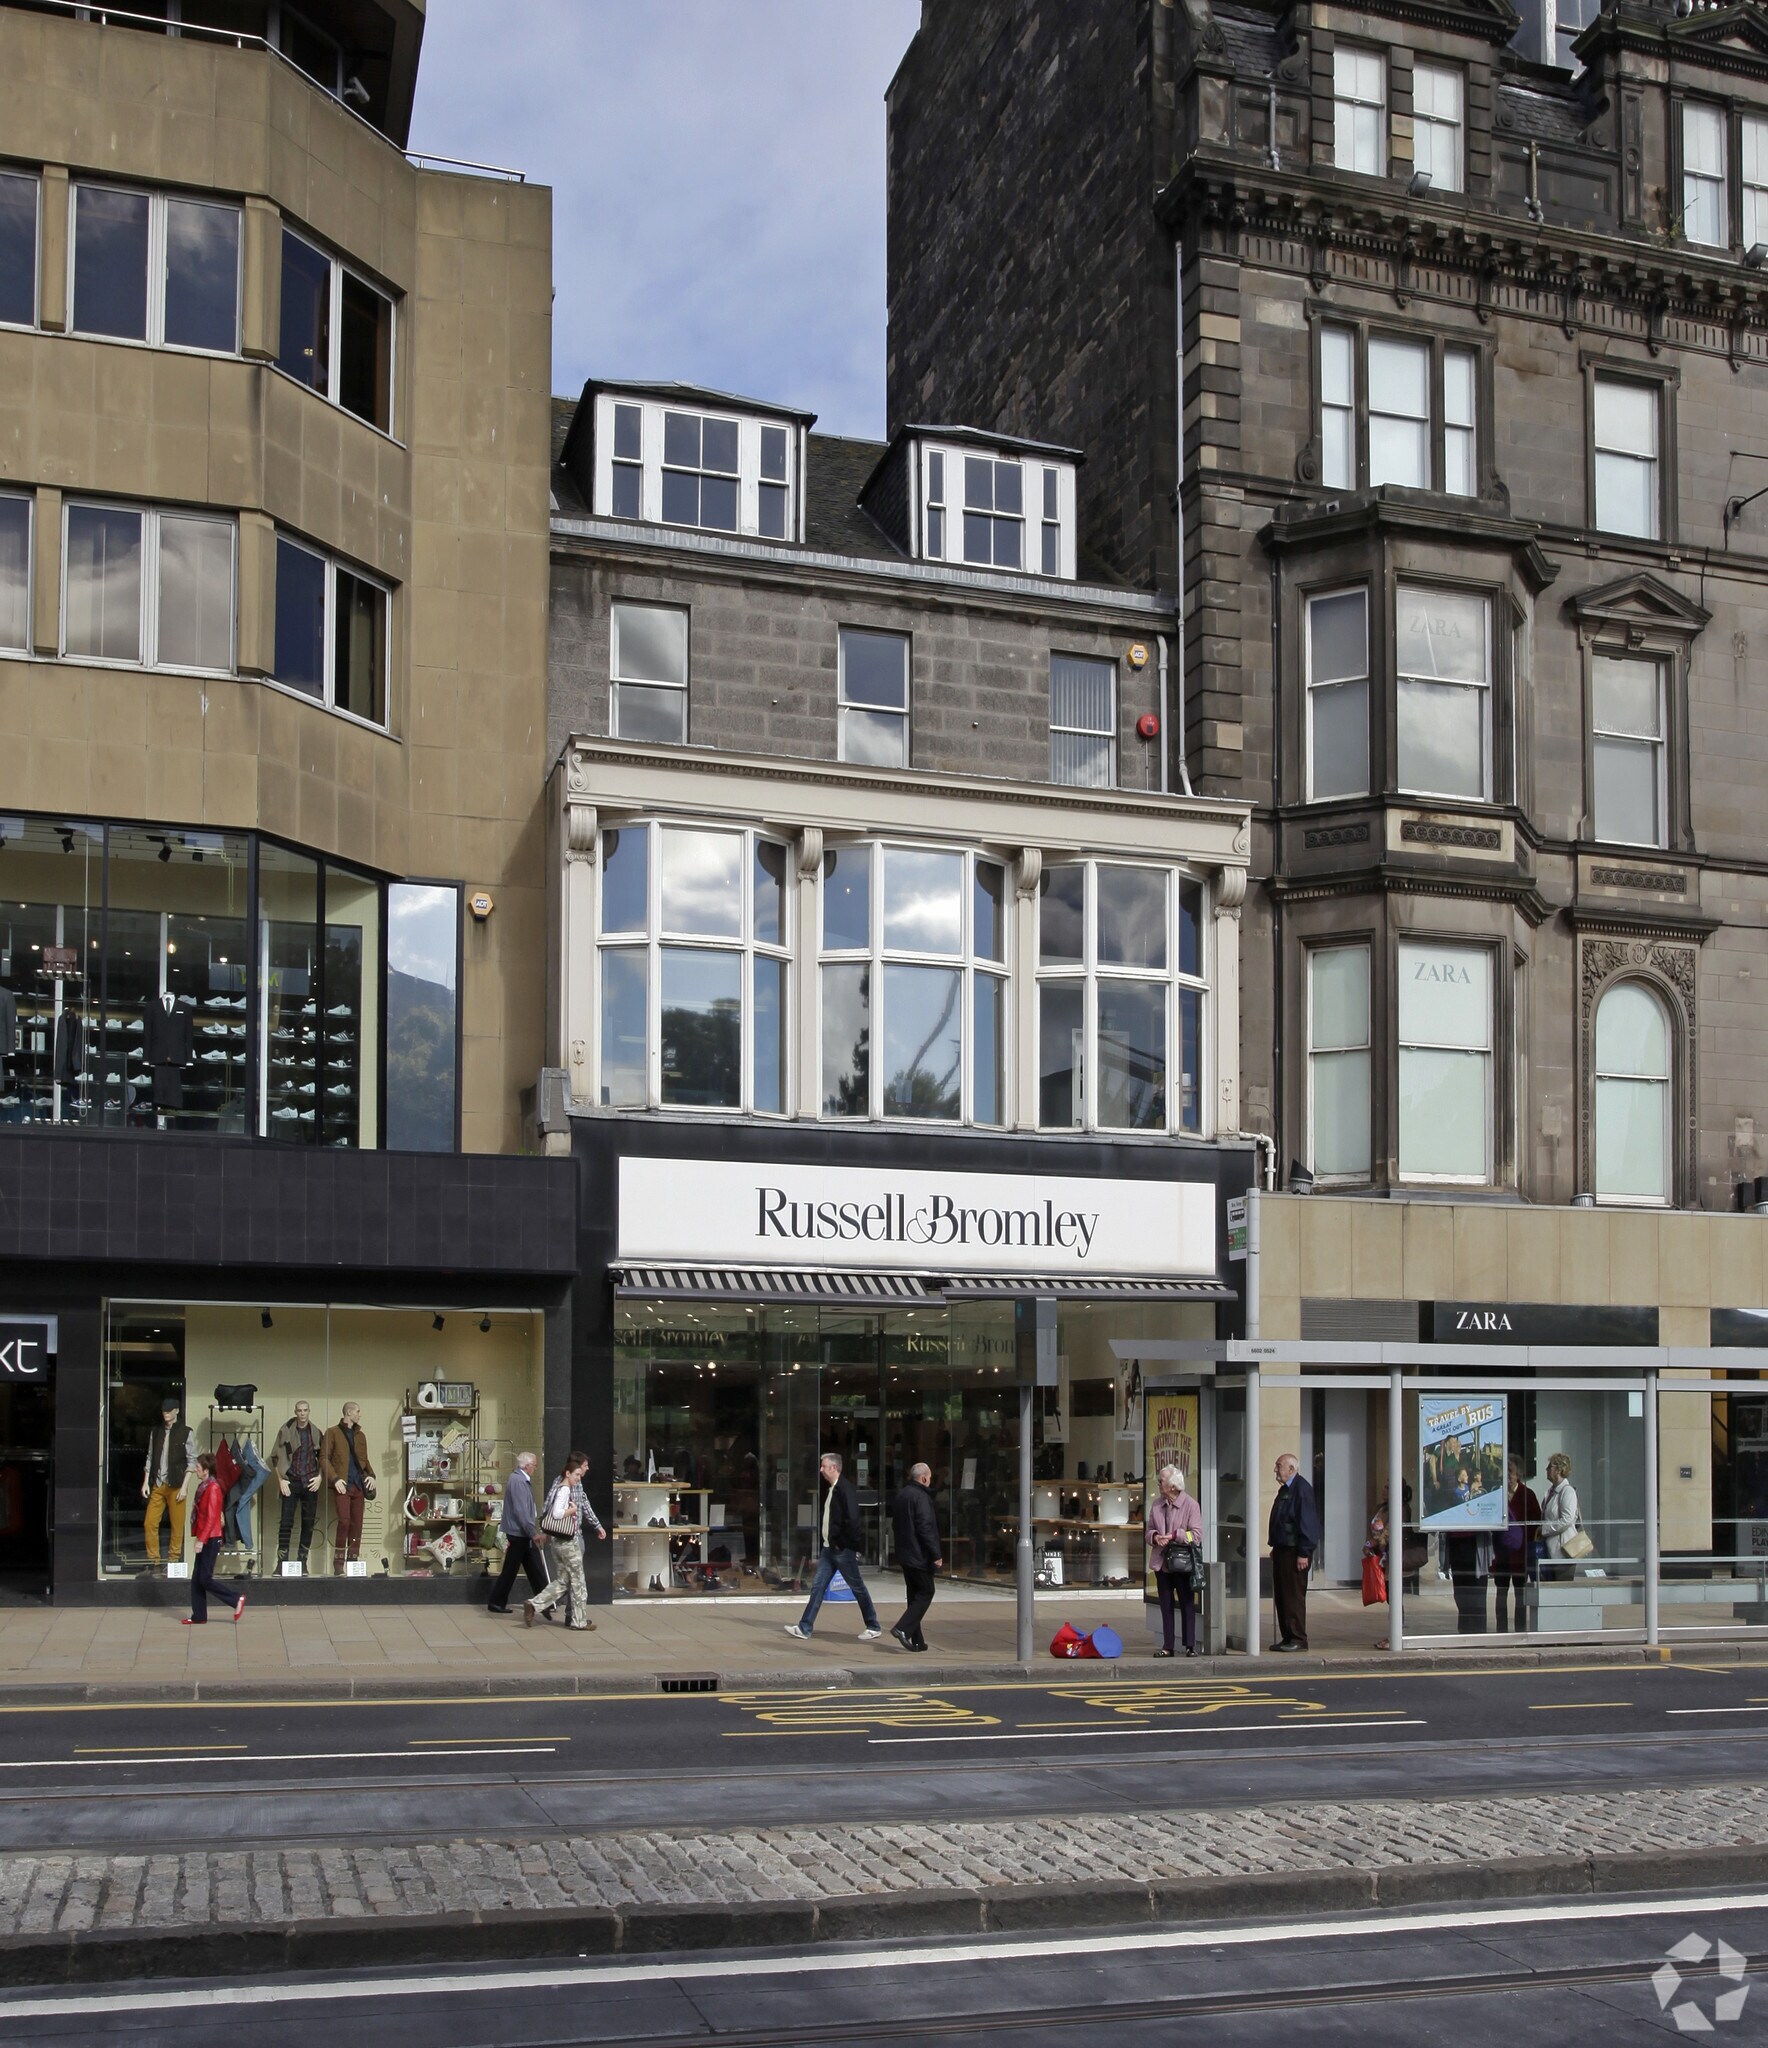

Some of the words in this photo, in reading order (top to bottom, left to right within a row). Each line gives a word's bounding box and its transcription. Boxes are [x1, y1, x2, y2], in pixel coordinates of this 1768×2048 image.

[1409, 615, 1461, 638] ZARA
[1414, 961, 1471, 984] ZARA
[1456, 1311, 1513, 1331] ZARA
[1158, 1407, 1177, 1432] DIVE
[1178, 1408, 1188, 1432] IN
[1426, 1409, 1460, 1428] TRAVEL
[1460, 1405, 1471, 1417] BY
[1468, 1404, 1494, 1427] BUS
[1436, 1421, 1452, 1432] GREAT
[1452, 1423, 1464, 1432] OUT
[1153, 1432, 1179, 1450] WITHOUT
[1180, 1434, 1192, 1453] THE
[1180, 1452, 1190, 1477] IN
